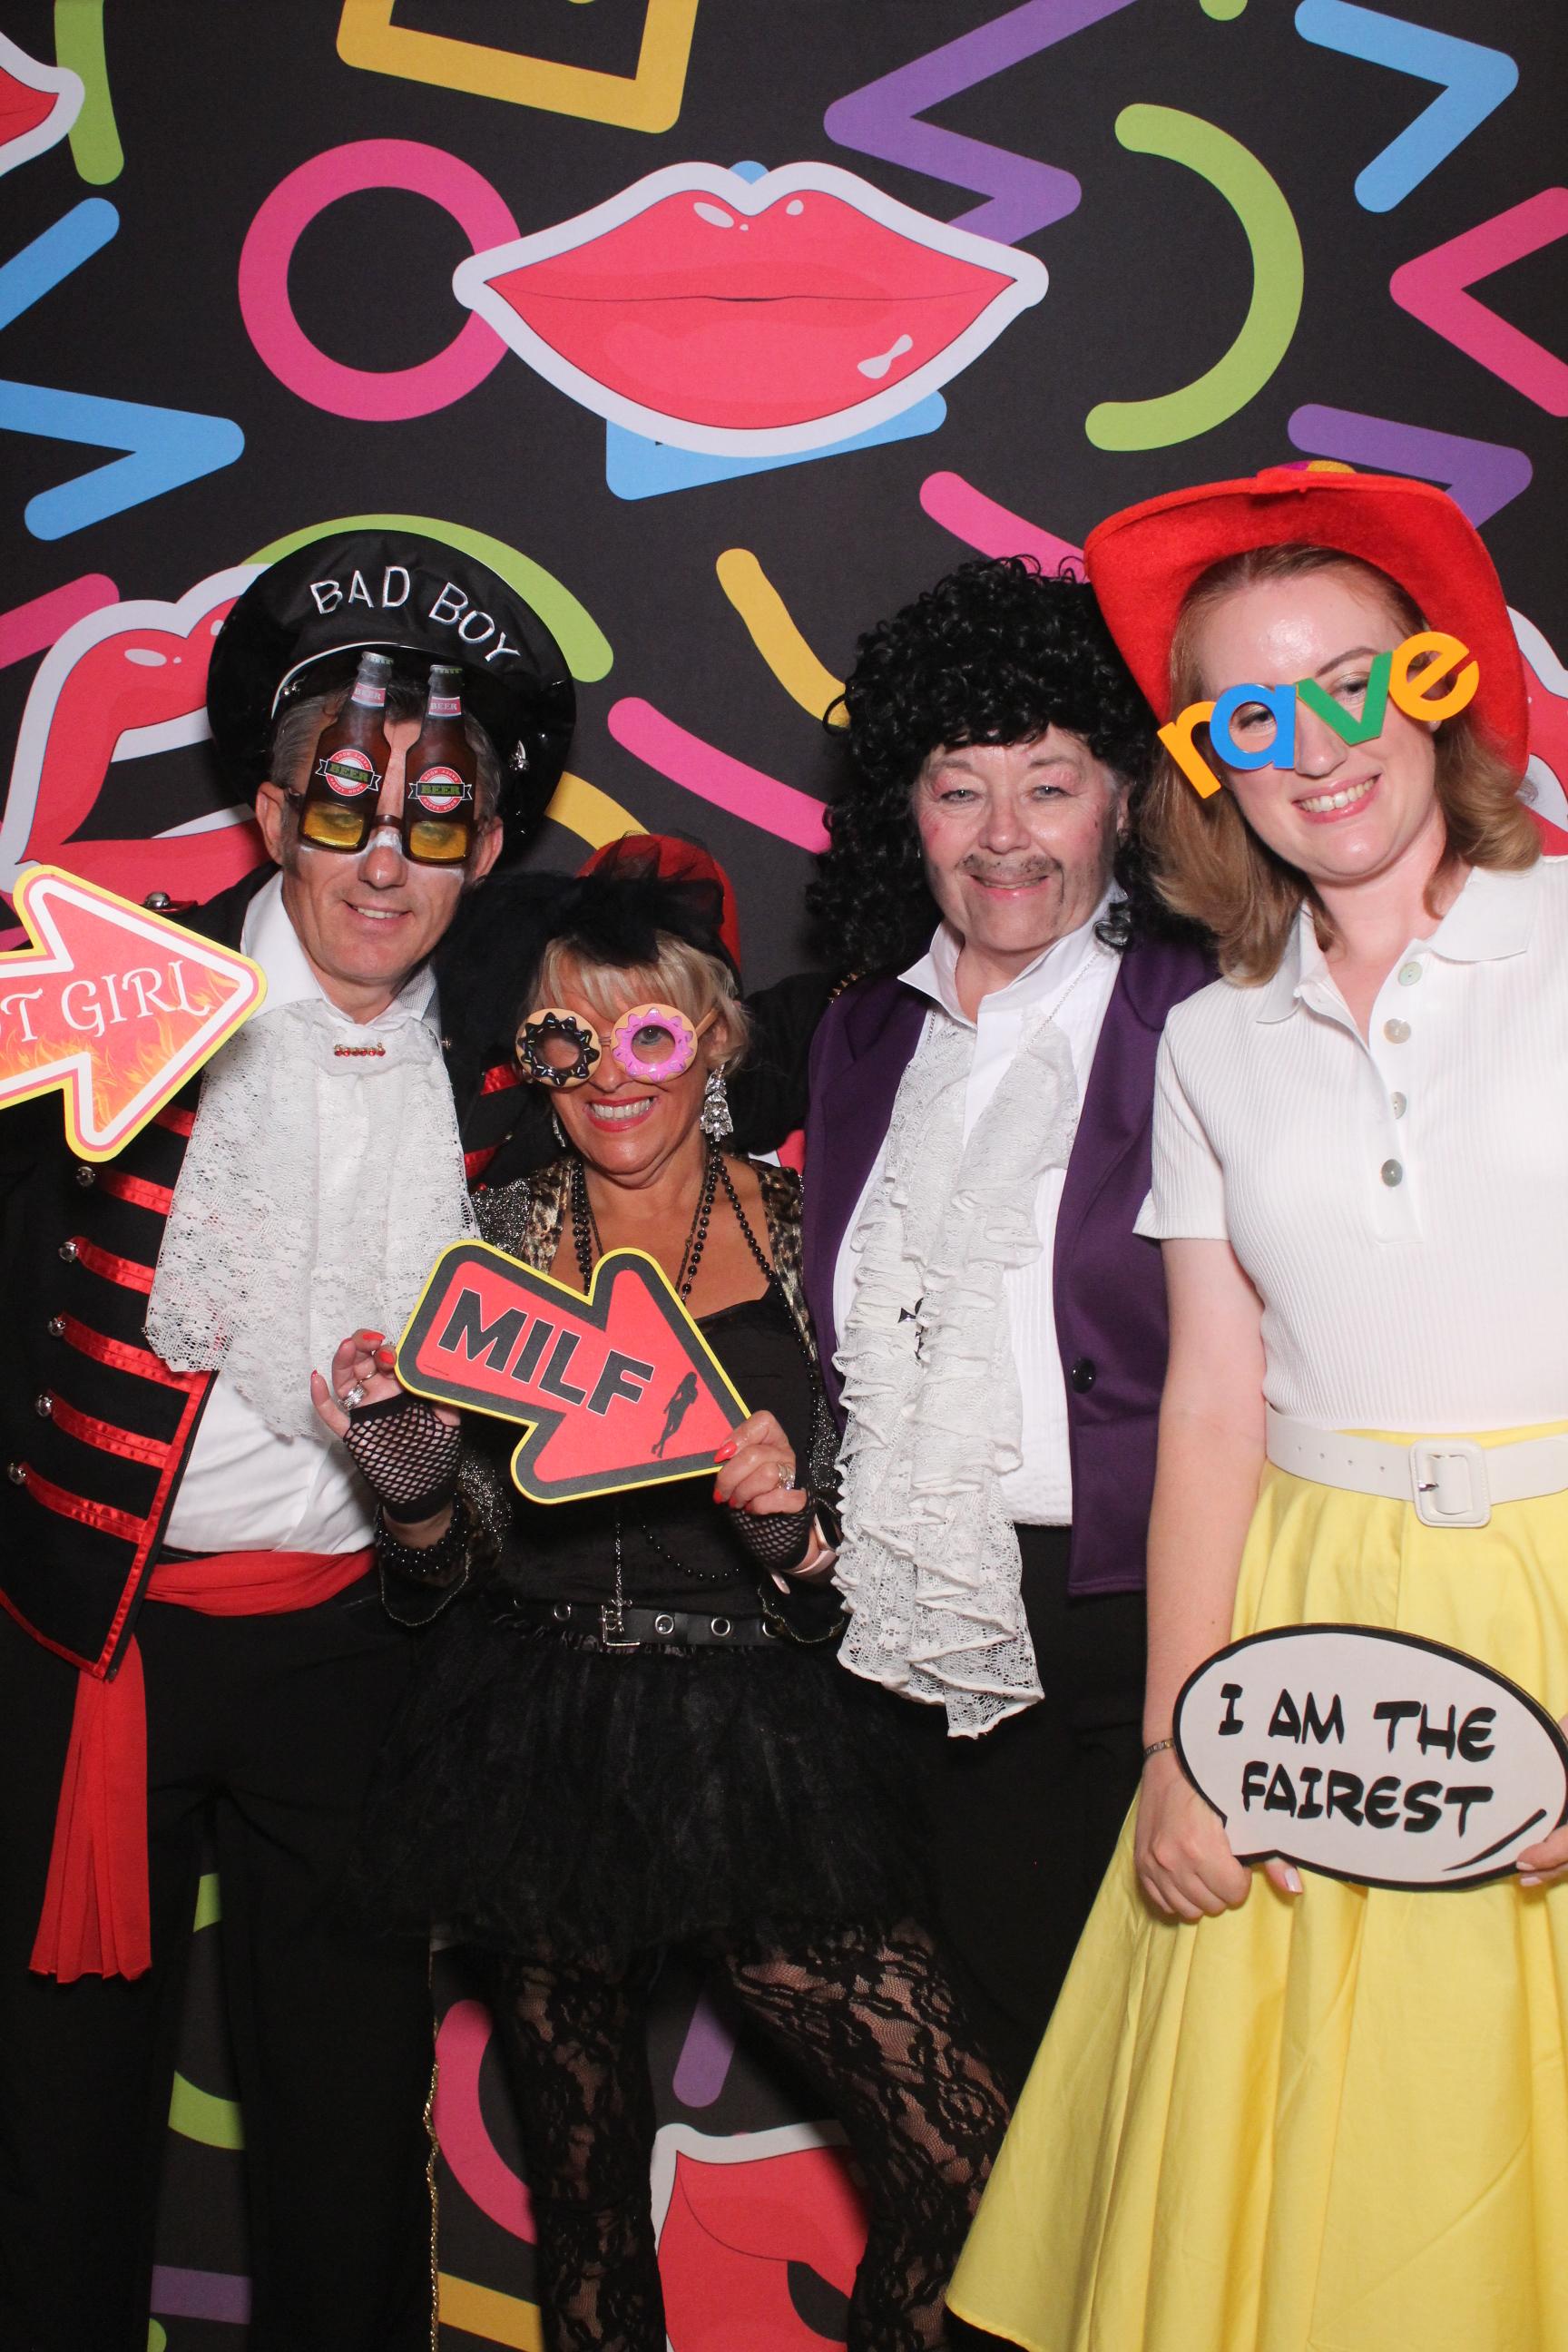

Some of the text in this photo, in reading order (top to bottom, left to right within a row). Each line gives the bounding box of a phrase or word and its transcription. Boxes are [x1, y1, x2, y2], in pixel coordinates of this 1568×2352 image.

[310, 565, 522, 662] BAD BOY
[355, 688, 381, 700] BEER
[430, 702, 457, 710] BEER
[1157, 631, 1480, 799] rave
[330, 763, 368, 782] BEER
[421, 784, 460, 796] BEER
[0, 960, 211, 1043] T GIRL
[436, 1287, 655, 1416] MILF
[1218, 1682, 1496, 1762] I AM THE
[1241, 1760, 1494, 1838] FAIREST
